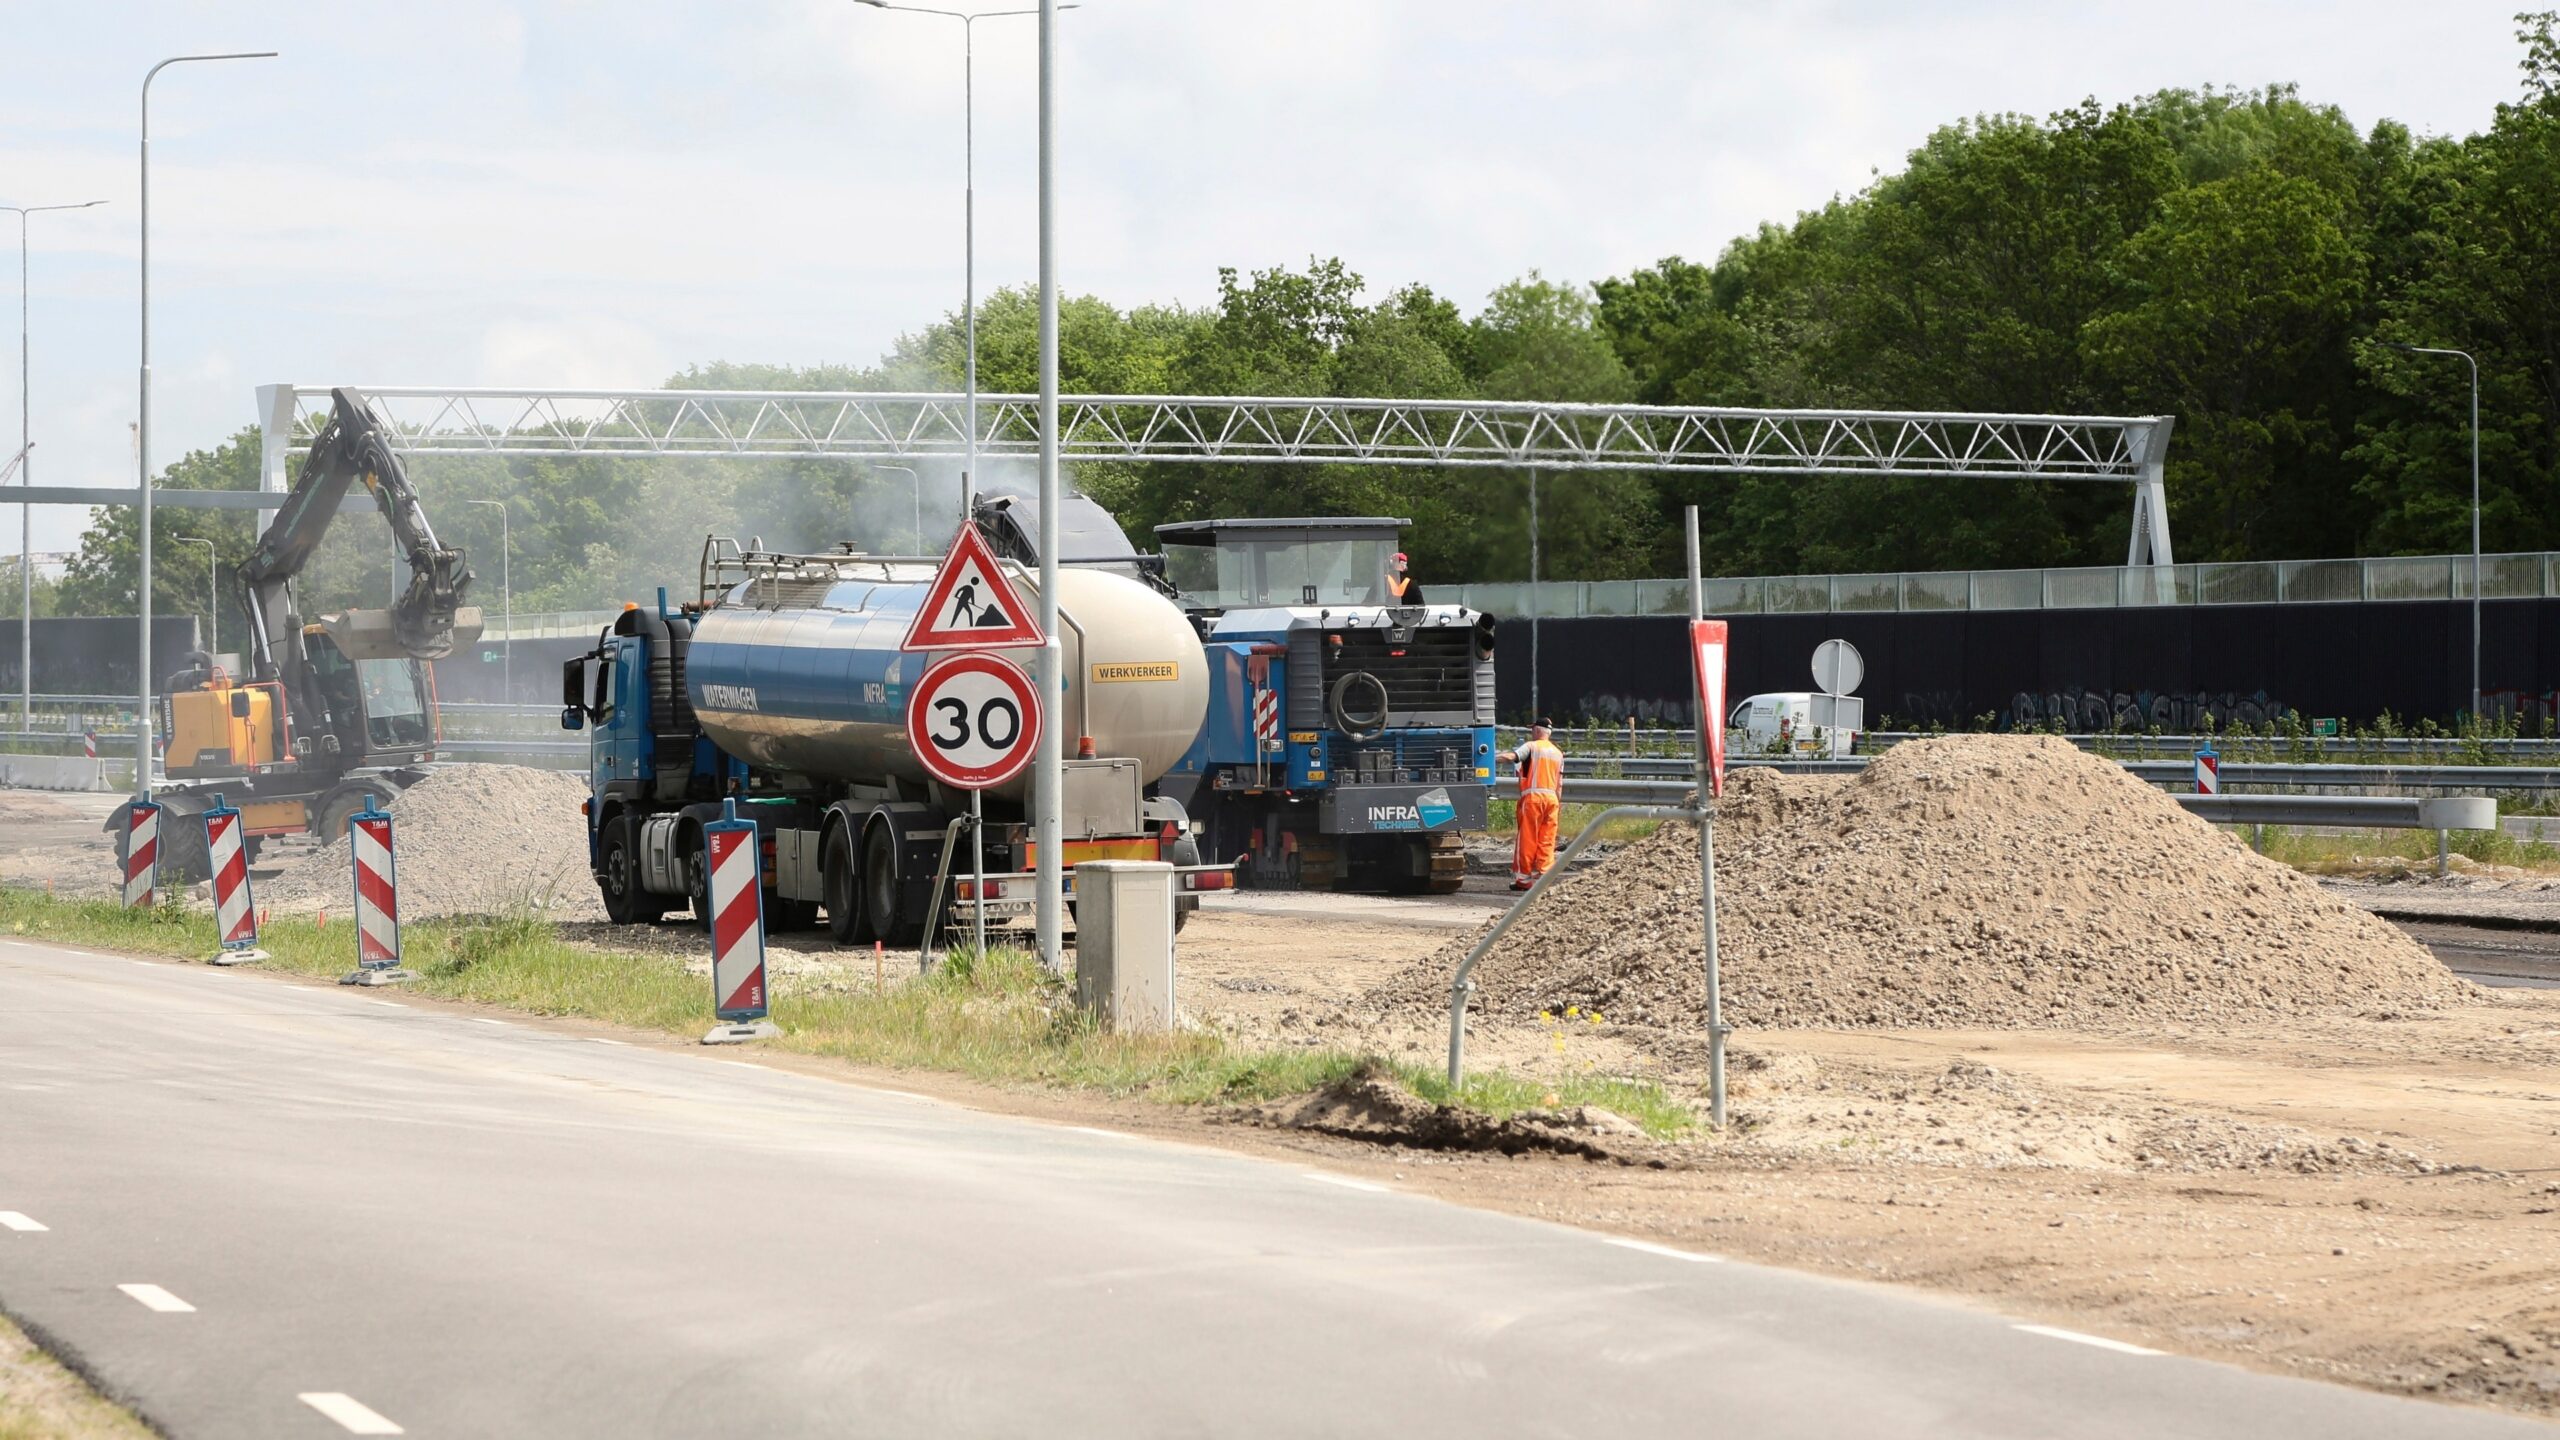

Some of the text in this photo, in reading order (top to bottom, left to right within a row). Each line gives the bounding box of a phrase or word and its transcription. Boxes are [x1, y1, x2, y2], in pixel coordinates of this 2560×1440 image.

[1099, 666, 1172, 679] WERKVERKEER
[701, 684, 759, 711] WATERWAGEN
[863, 682, 887, 704] INFRA
[930, 697, 1020, 750] 30
[1368, 806, 1420, 820] INFRA
[371, 820, 388, 829] T&M
[1372, 820, 1421, 830] TECHNIEK
[711, 834, 721, 853] T&M
[751, 986, 761, 1006] T&M
